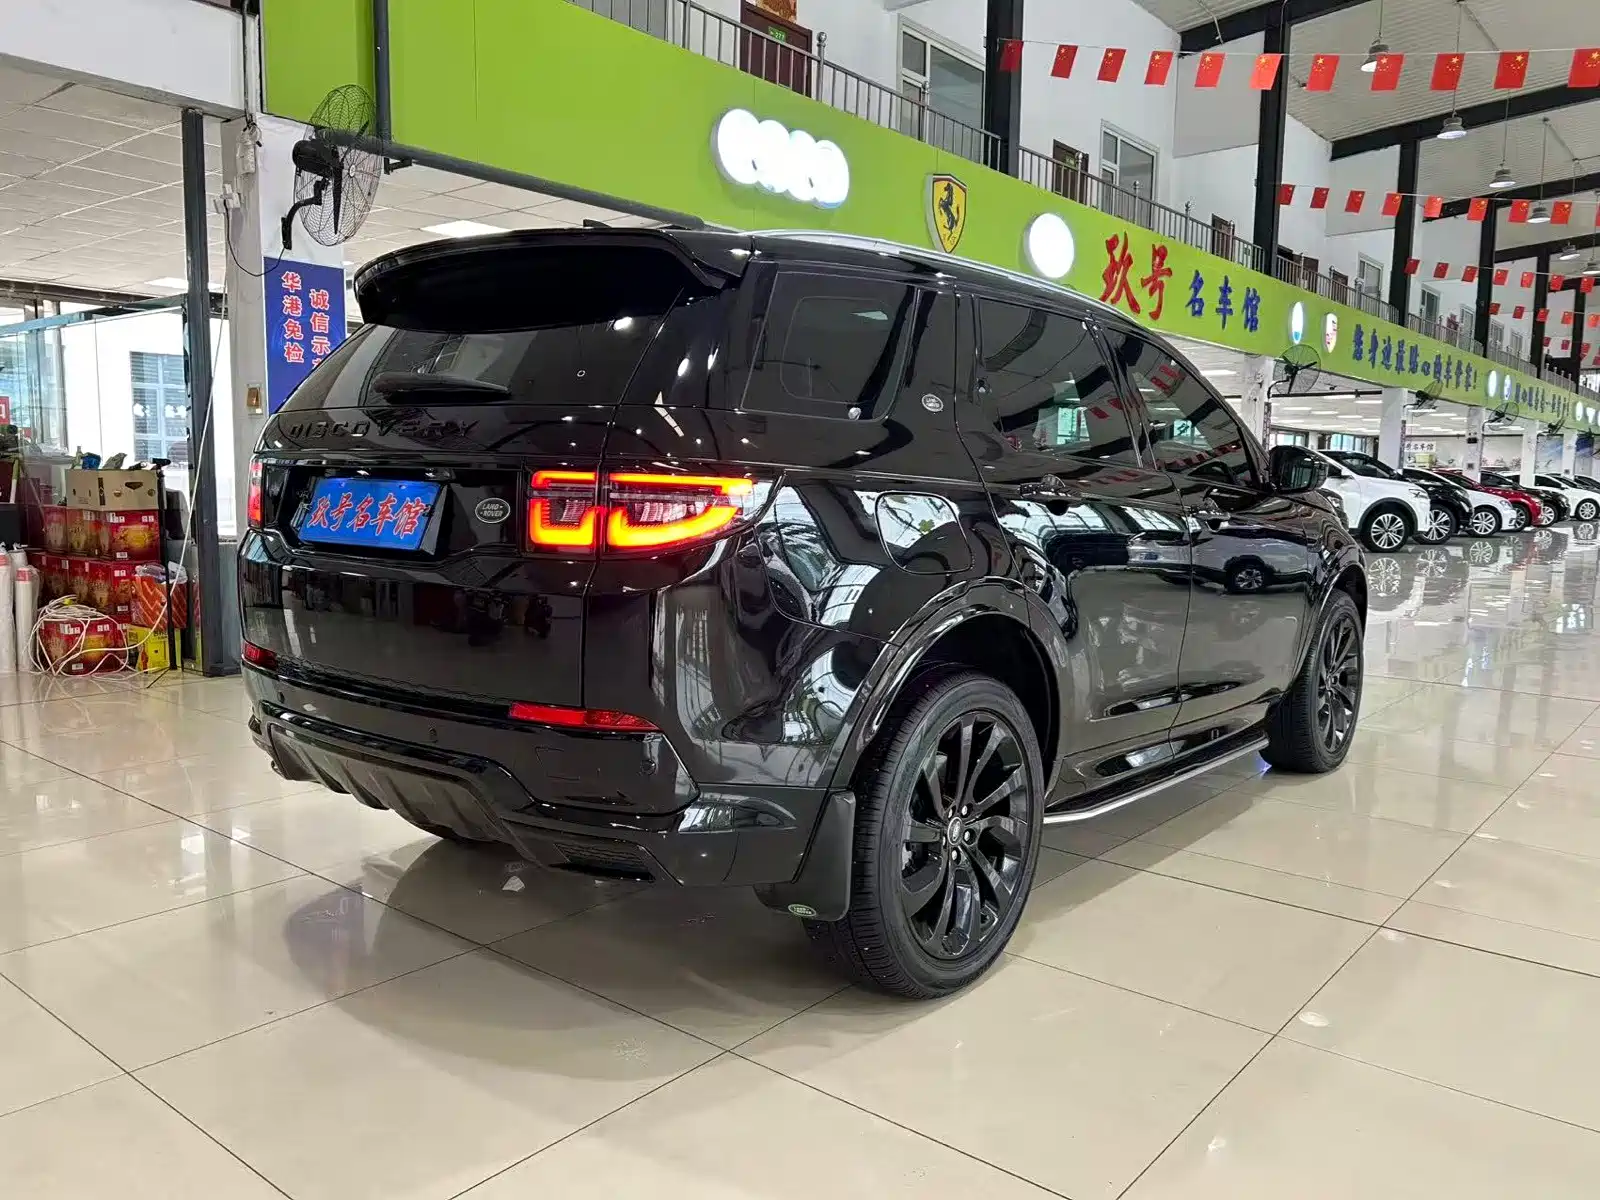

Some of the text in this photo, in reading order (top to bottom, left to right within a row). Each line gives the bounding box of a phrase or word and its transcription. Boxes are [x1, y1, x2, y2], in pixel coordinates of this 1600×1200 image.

[281, 271, 305, 364] 华港免检
[289, 420, 479, 438] DISCOVERY
[307, 492, 430, 540] 玖号名车馆
